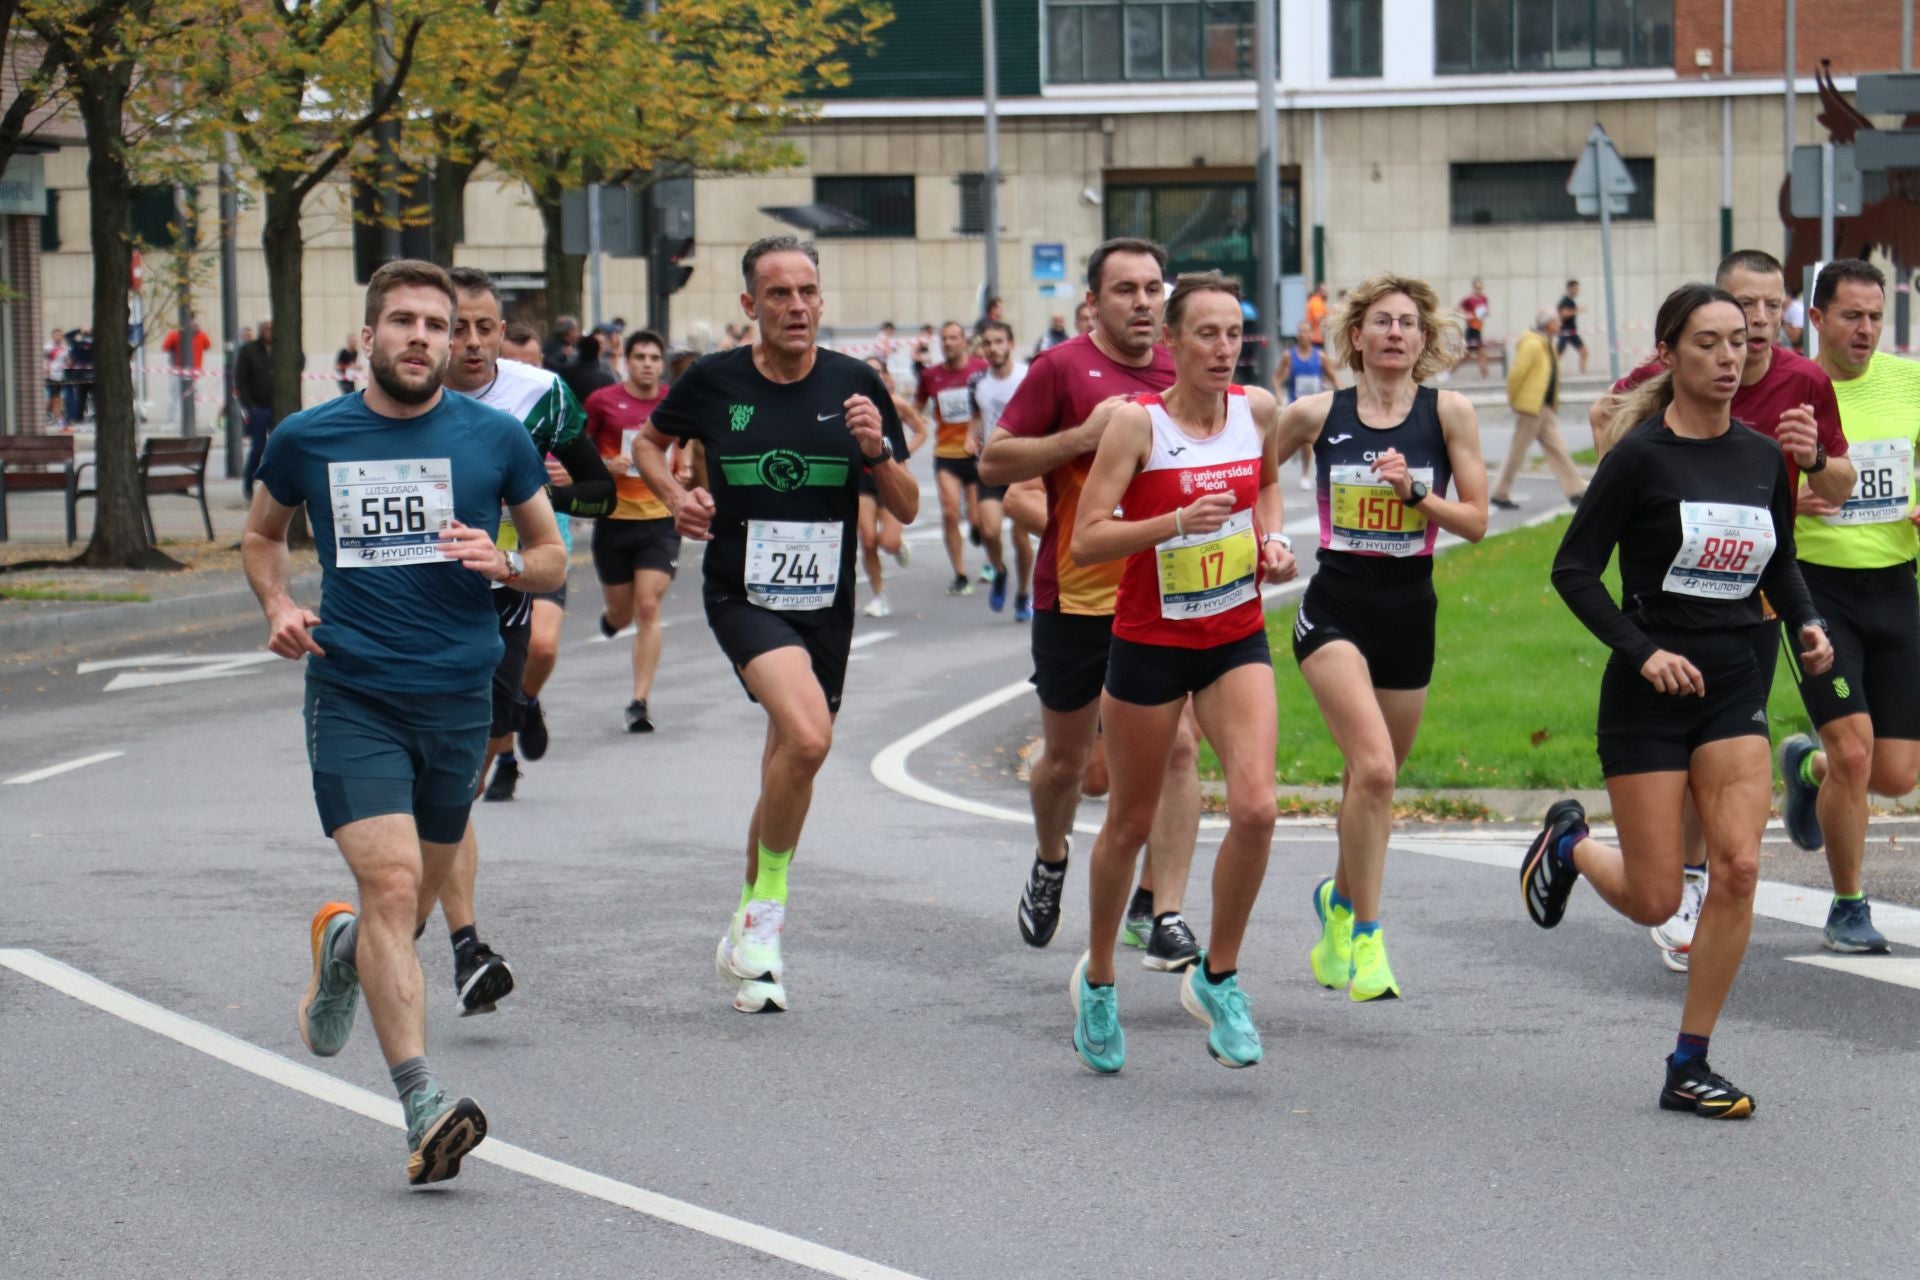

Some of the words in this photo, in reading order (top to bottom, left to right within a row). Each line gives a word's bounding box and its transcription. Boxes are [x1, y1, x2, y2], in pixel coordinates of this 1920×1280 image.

[1193, 463, 1253, 481] universidad
[1204, 478, 1227, 491] león
[1851, 468, 1893, 500] 86
[361, 496, 426, 536] 556
[1358, 497, 1404, 531] 150
[1859, 507, 1899, 518] HYUNDAI
[1723, 528, 1741, 537] SARA
[1366, 540, 1411, 551] HYUNDAI
[1696, 537, 1755, 571] 896
[770, 553, 819, 584] 244
[1200, 551, 1224, 589] 17
[1702, 580, 1743, 592] HYUNDAI
[782, 595, 823, 604] HYUNDAI
[1203, 590, 1243, 609] HYUNDAI
